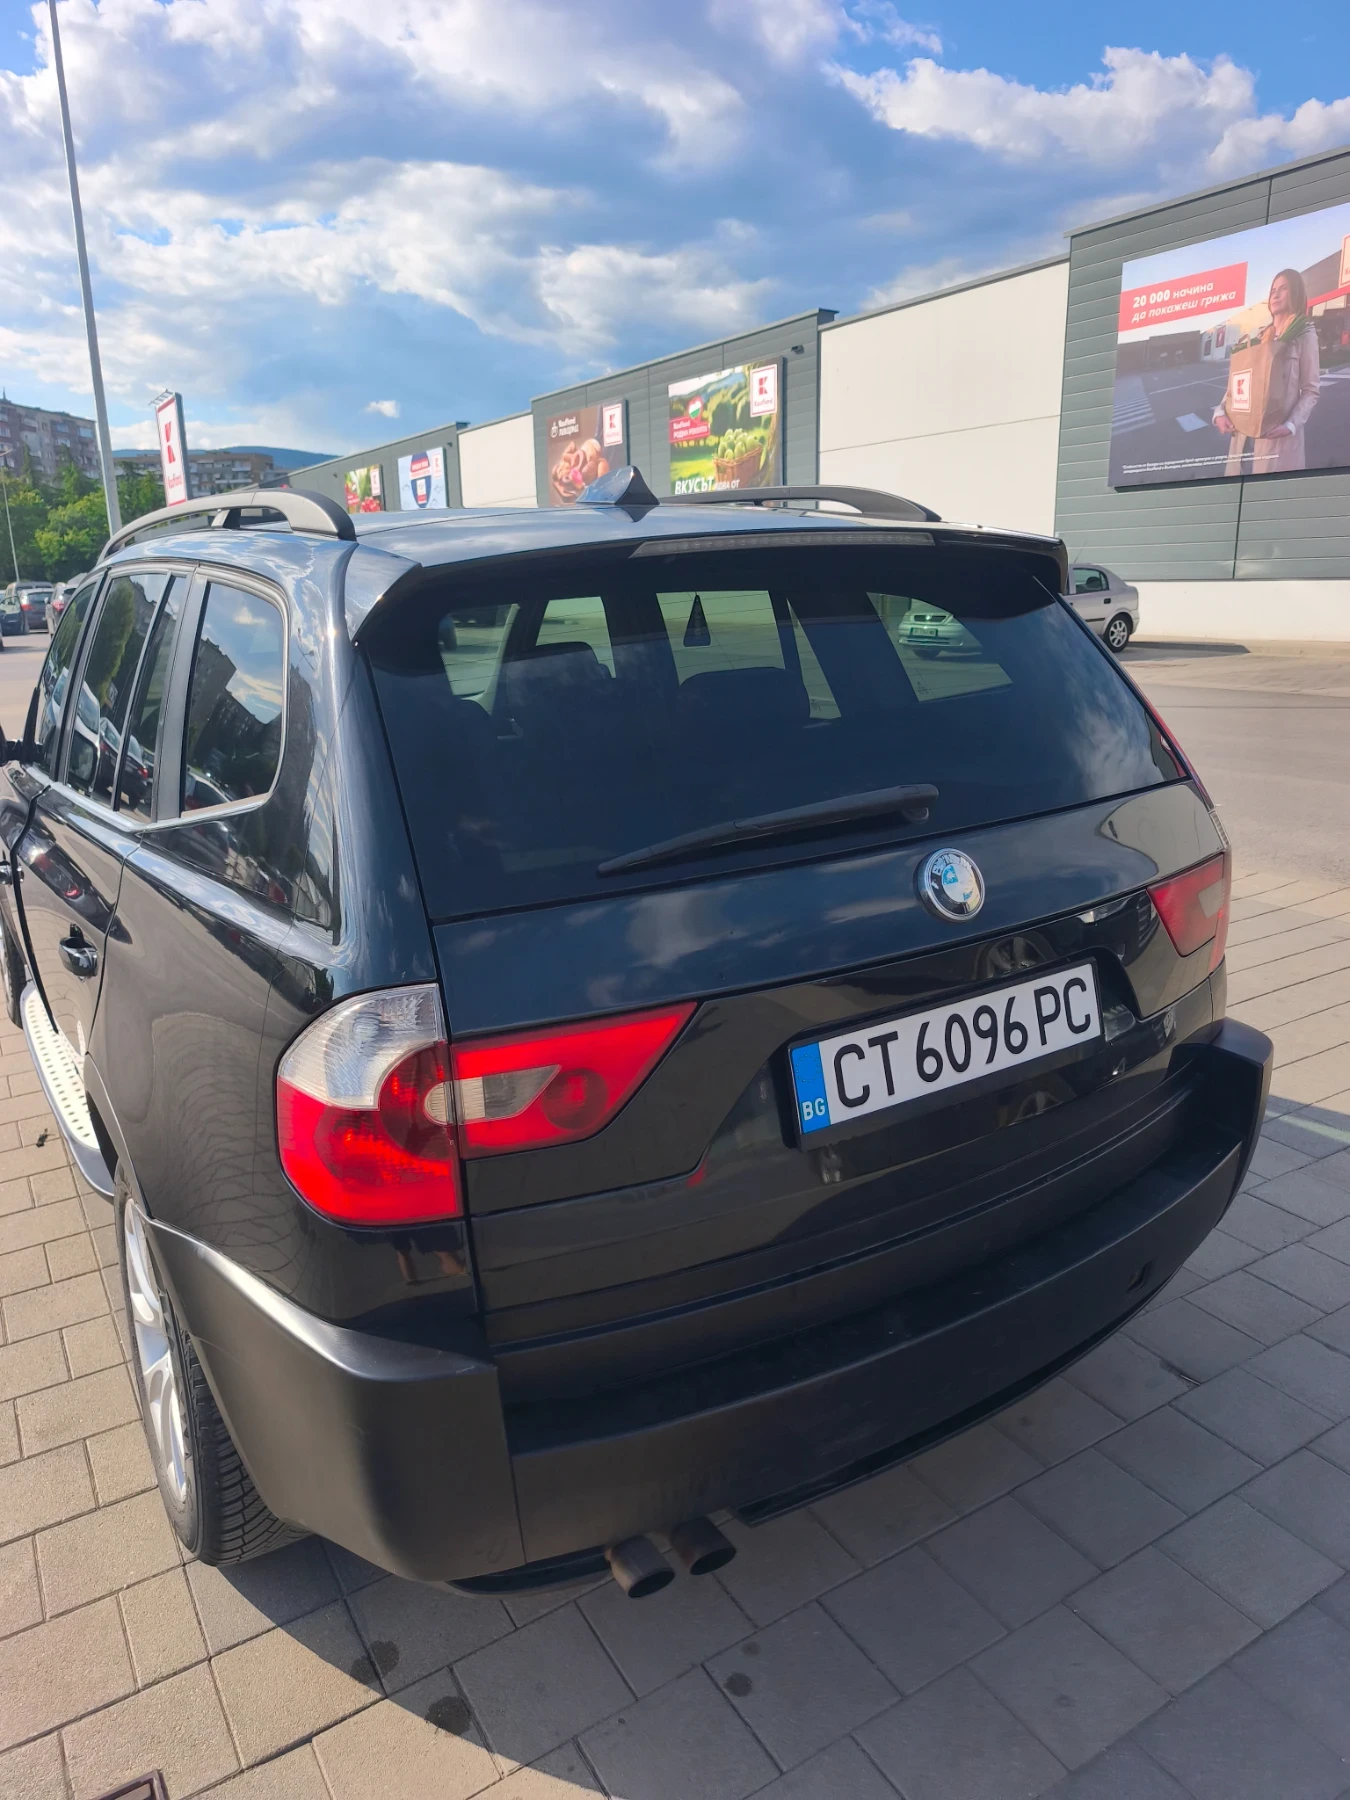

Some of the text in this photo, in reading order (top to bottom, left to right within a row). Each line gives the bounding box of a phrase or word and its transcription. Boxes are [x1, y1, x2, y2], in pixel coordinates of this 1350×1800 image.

[1131, 290, 1237, 323] да покажеш грижа
[1133, 282, 1214, 308] 20 000 начина
[674, 476, 714, 495] ВКУСЪТ
[730, 479, 741, 489] ОТ
[833, 977, 1091, 1108] CT 6096 PC
[802, 1097, 826, 1121] BG
